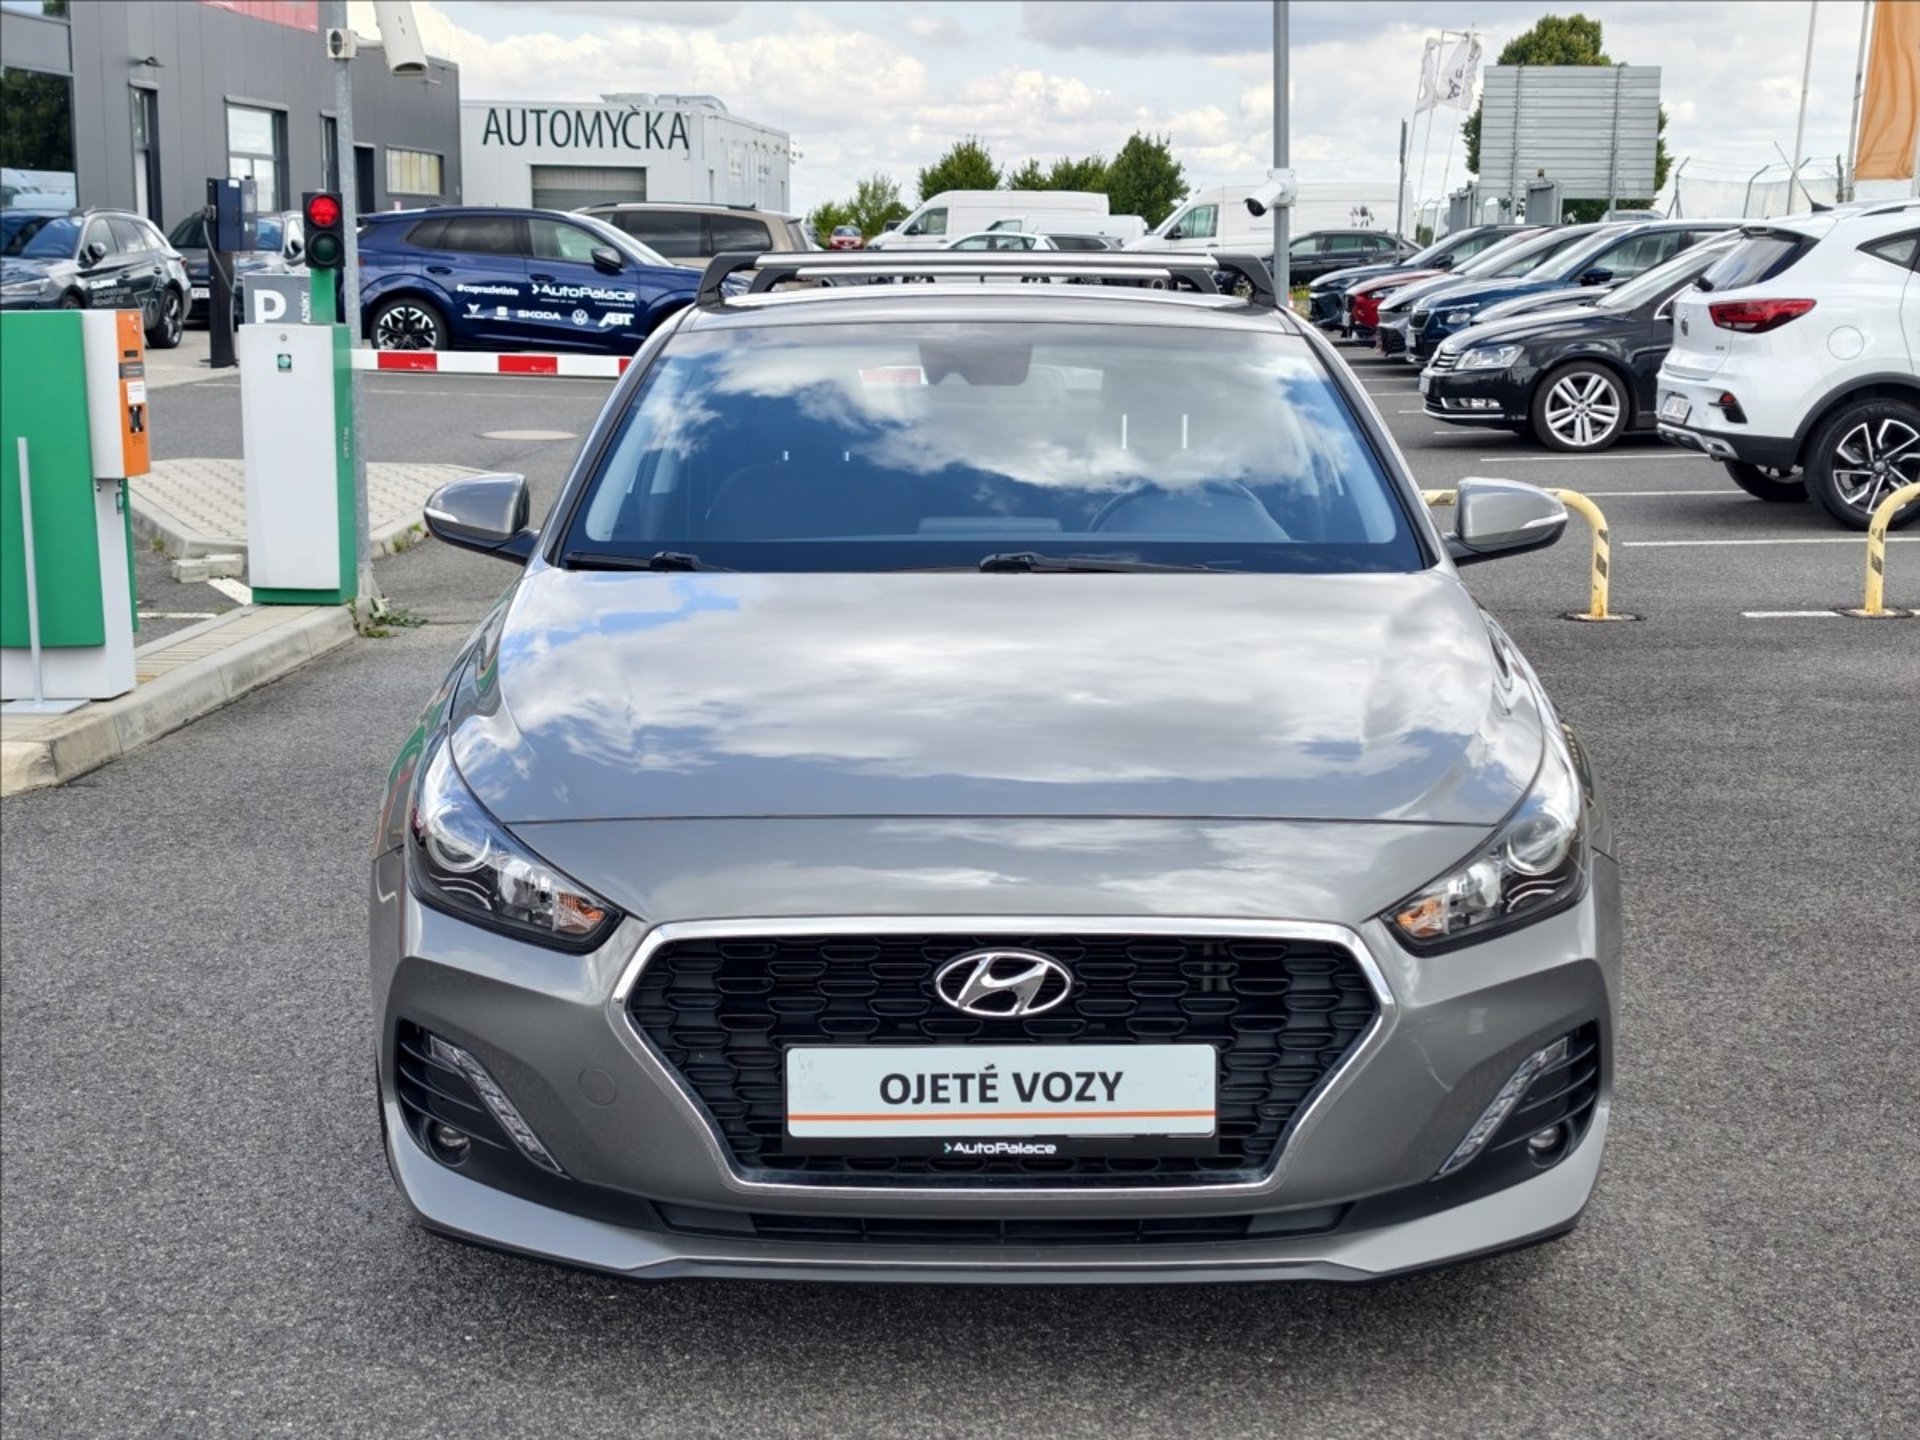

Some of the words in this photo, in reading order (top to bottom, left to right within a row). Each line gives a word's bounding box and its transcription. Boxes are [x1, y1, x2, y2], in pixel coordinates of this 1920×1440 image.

[482, 104, 690, 150] AUTOMYČKA
[254, 289, 286, 323] P
[541, 284, 636, 301] AutoPalace
[879, 1063, 999, 1105] OJETÉ
[1011, 1071, 1124, 1103] VOZY
[953, 1142, 1057, 1155] AutoPalace
